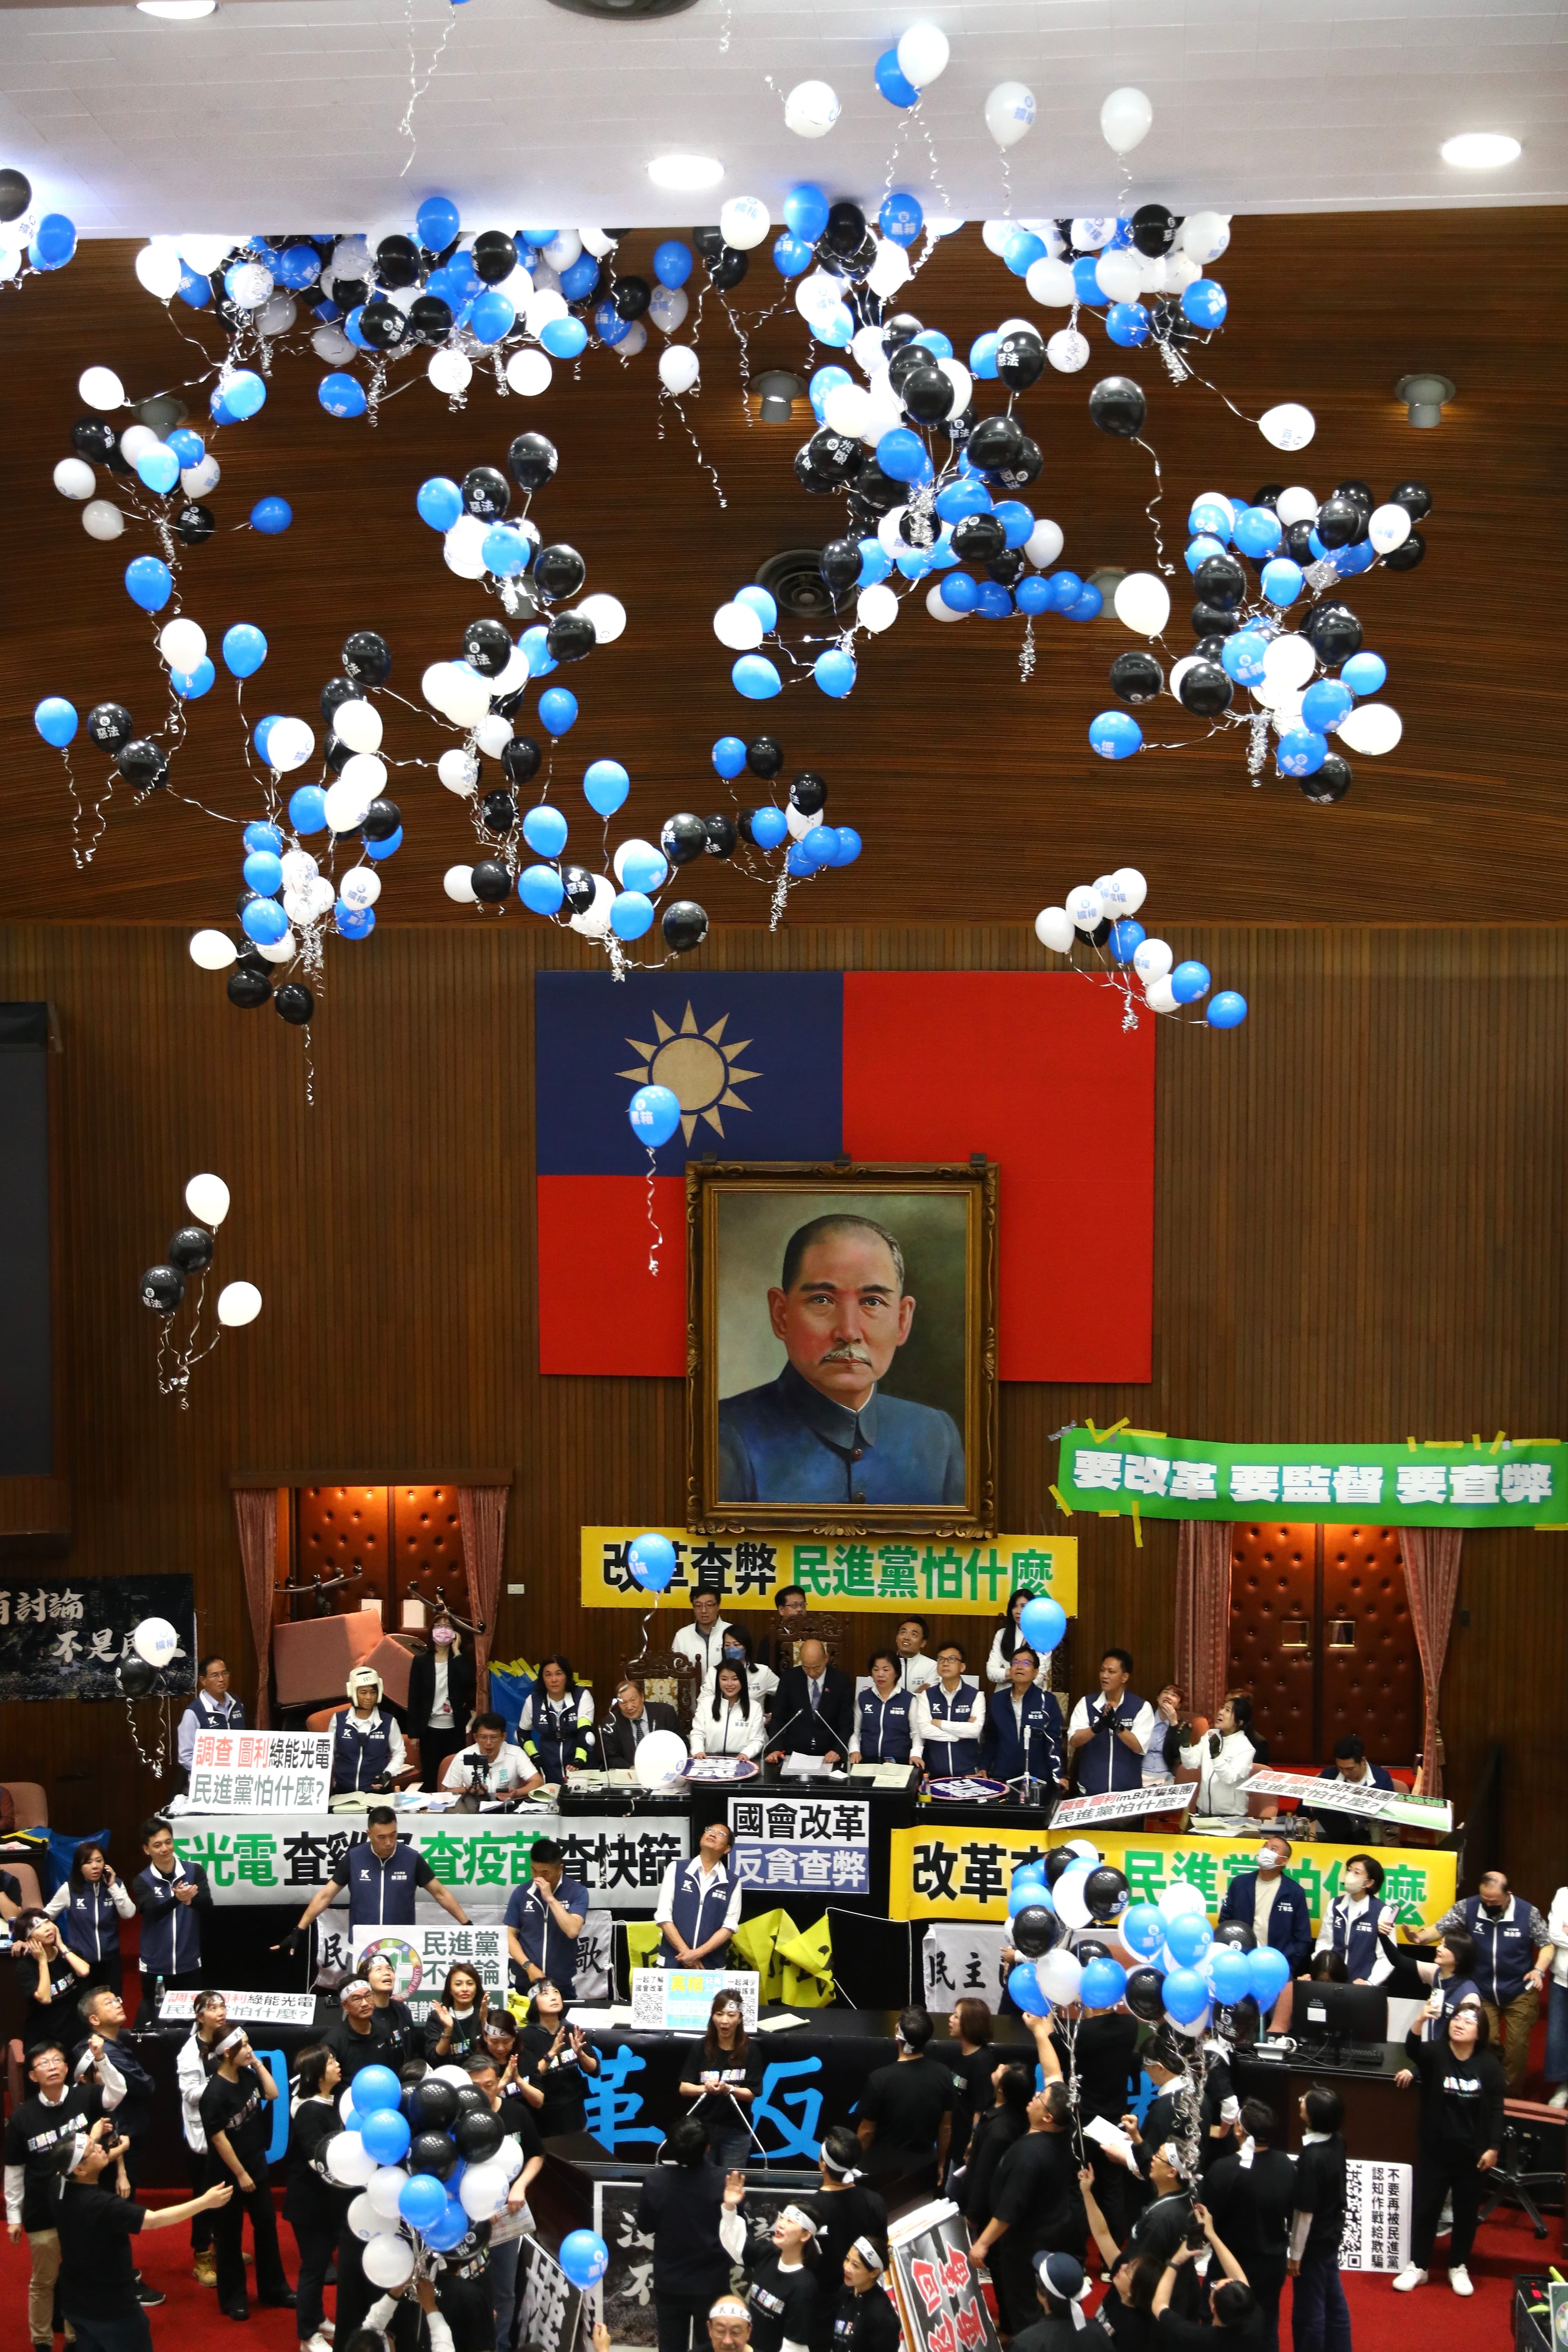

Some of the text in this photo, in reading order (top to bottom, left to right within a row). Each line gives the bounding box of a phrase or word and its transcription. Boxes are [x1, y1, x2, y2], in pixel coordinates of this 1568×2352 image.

[892, 223, 916, 234] 黑箱
[1004, 342, 1014, 352] 反
[998, 353, 1019, 367] 惡法
[949, 428, 969, 439] 惡法
[828, 439, 838, 450] 反
[833, 440, 854, 465] 惡法
[474, 490, 484, 500] 反
[469, 499, 494, 513] 惡法
[470, 643, 479, 653] 反
[465, 653, 490, 666] 惡法
[100, 717, 110, 726] 反
[96, 726, 120, 739] 惡法
[143, 1296, 163, 1308] 惡法
[146, 1288, 155, 1298] 反
[1074, 1450, 1552, 1504] 要改革 要監督 要查弊
[793, 1544, 1054, 1601] 民進黨怕什麼
[52, 1628, 187, 1663] 不是
[196, 1736, 331, 1770] 調查 圖利綠能光電
[1255, 1772, 1287, 1782] 調查
[192, 1773, 325, 1806] 民進黨怕什麼?
[1244, 1781, 1380, 1809] 民進黨怕什麼?
[1054, 1797, 1187, 1825] 民進黨怕什麼?
[1060, 1798, 1087, 1811] 調查
[735, 1802, 866, 1841] 國會改革
[420, 1831, 550, 1886] 查疫苗
[556, 1833, 681, 1889] 查快篩
[734, 1848, 866, 1888] 反貪查弊
[423, 1931, 499, 1956] 民進黨
[413, 1968, 421, 1986] PARTY
[422, 1959, 500, 1985] 不論
[670, 1975, 704, 1993] 真相
[164, 2005, 308, 2019] 民怕什麼?
[1372, 2167, 1384, 2269] 認知作戰給欺騙
[1387, 2168, 1400, 2270] 不要再被民進黨
